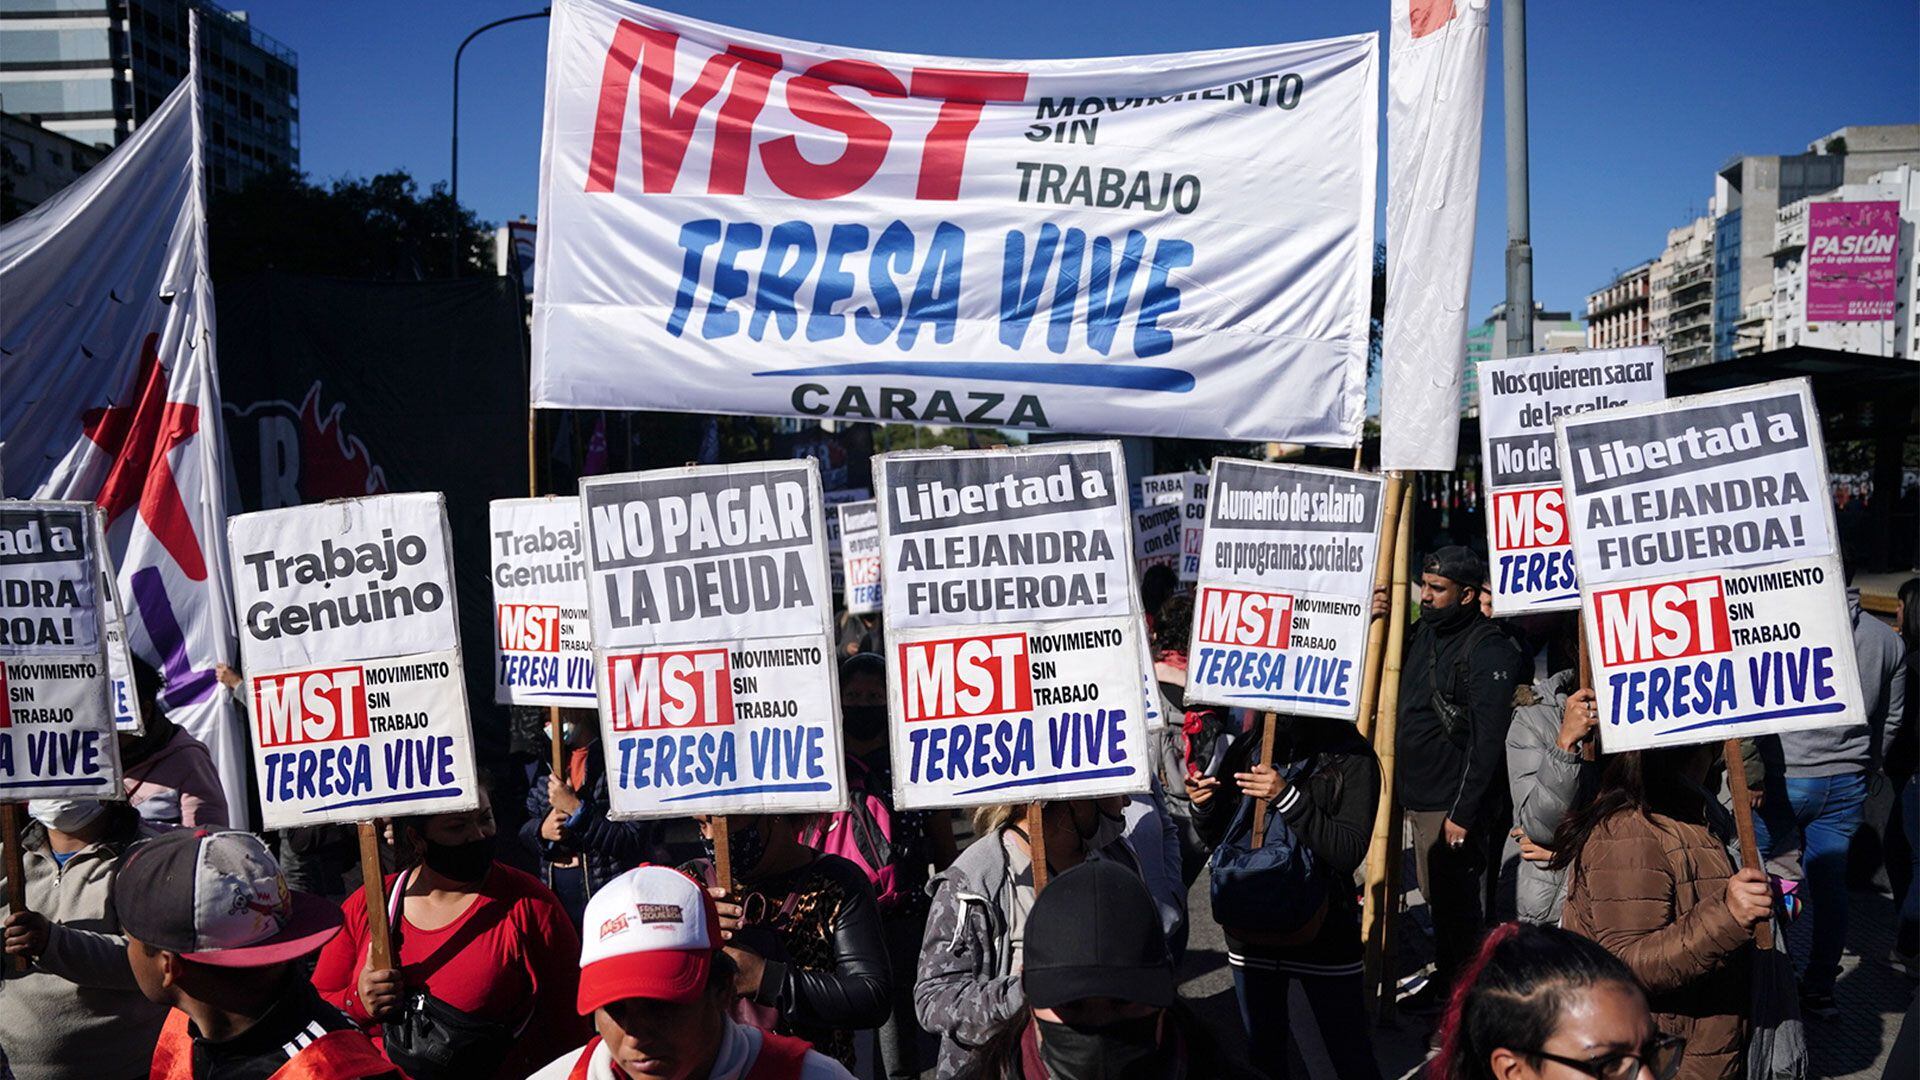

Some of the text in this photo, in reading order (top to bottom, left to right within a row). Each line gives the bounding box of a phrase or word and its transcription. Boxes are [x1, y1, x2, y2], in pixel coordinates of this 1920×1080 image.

[585, 18, 1029, 200] MST
[1023, 116, 1099, 145] SIN
[1016, 161, 1201, 215] TRABAJO
[1811, 229, 1896, 255] PASIÓN
[665, 218, 1195, 359] TERESA VIVE
[1492, 361, 1654, 396] Nos quieren sacar
[790, 383, 1051, 428] CARAZA
[1519, 403, 1542, 428] de
[1496, 443, 1524, 474] No
[1527, 440, 1552, 472] de
[1578, 411, 1761, 484] Libertad
[1766, 412, 1799, 443] a
[896, 464, 1074, 524] Libertad
[1081, 470, 1108, 499] a
[1217, 482, 1364, 524] Aumento de salario
[1587, 471, 1810, 529] ALEJANDRA
[591, 481, 808, 563] NO PAGAR
[1138, 506, 1179, 532] Romper
[51, 526, 76, 552] a
[495, 521, 582, 557] Trabaj
[897, 529, 1114, 572] ALEJANDRA
[1144, 535, 1162, 554] con
[1215, 540, 1233, 569] en
[1234, 539, 1307, 576] programas
[1309, 536, 1364, 573] sociales
[1597, 515, 1806, 571] FIGUEROA!
[243, 528, 427, 592] Trabajo
[1499, 549, 1579, 595] TERES
[604, 550, 814, 629] LA DEUDA
[907, 572, 1108, 615] FIGUEROA!
[1725, 566, 1824, 596] MOVIMIENTO
[246, 580, 444, 641] Genuino
[561, 608, 589, 620] MOVIM
[1201, 591, 1291, 647] MST
[1292, 616, 1310, 630] SIN
[1294, 598, 1361, 617] MOVIMIENTO
[1600, 580, 1719, 664] MST
[1729, 602, 1755, 621] SIN
[500, 605, 557, 651] MST
[561, 624, 574, 635] SIN
[1030, 628, 1122, 654] MOVIMIENTO
[1291, 635, 1336, 651] TRABAJO
[1732, 622, 1801, 647] TRABAJO
[8, 663, 96, 680] MOVIMIENTO
[366, 661, 449, 686] MOVIMIENTO
[499, 655, 559, 690] TERESA
[731, 647, 822, 669] MOVIMIENTO
[1032, 661, 1057, 680] SIN
[1195, 648, 1287, 691] TERESA
[1294, 654, 1352, 697] VIVE
[10, 686, 34, 702] SIN
[614, 652, 725, 729] MST
[733, 676, 758, 694] SIN
[906, 637, 1023, 720] MST
[1034, 683, 1099, 706] TRABAJO
[1609, 646, 1836, 725] TERESA VIVE
[12, 708, 74, 724] TRABAJO
[259, 670, 361, 745] MST
[368, 692, 391, 709] SIN
[735, 700, 798, 720] TRABAJO
[370, 712, 428, 733] TRABAJO
[28, 730, 99, 777] VIVE
[618, 725, 824, 790] TERESA VIVE
[909, 708, 1128, 784] TERESA VIVE
[264, 735, 455, 803] TERESA VIVE
